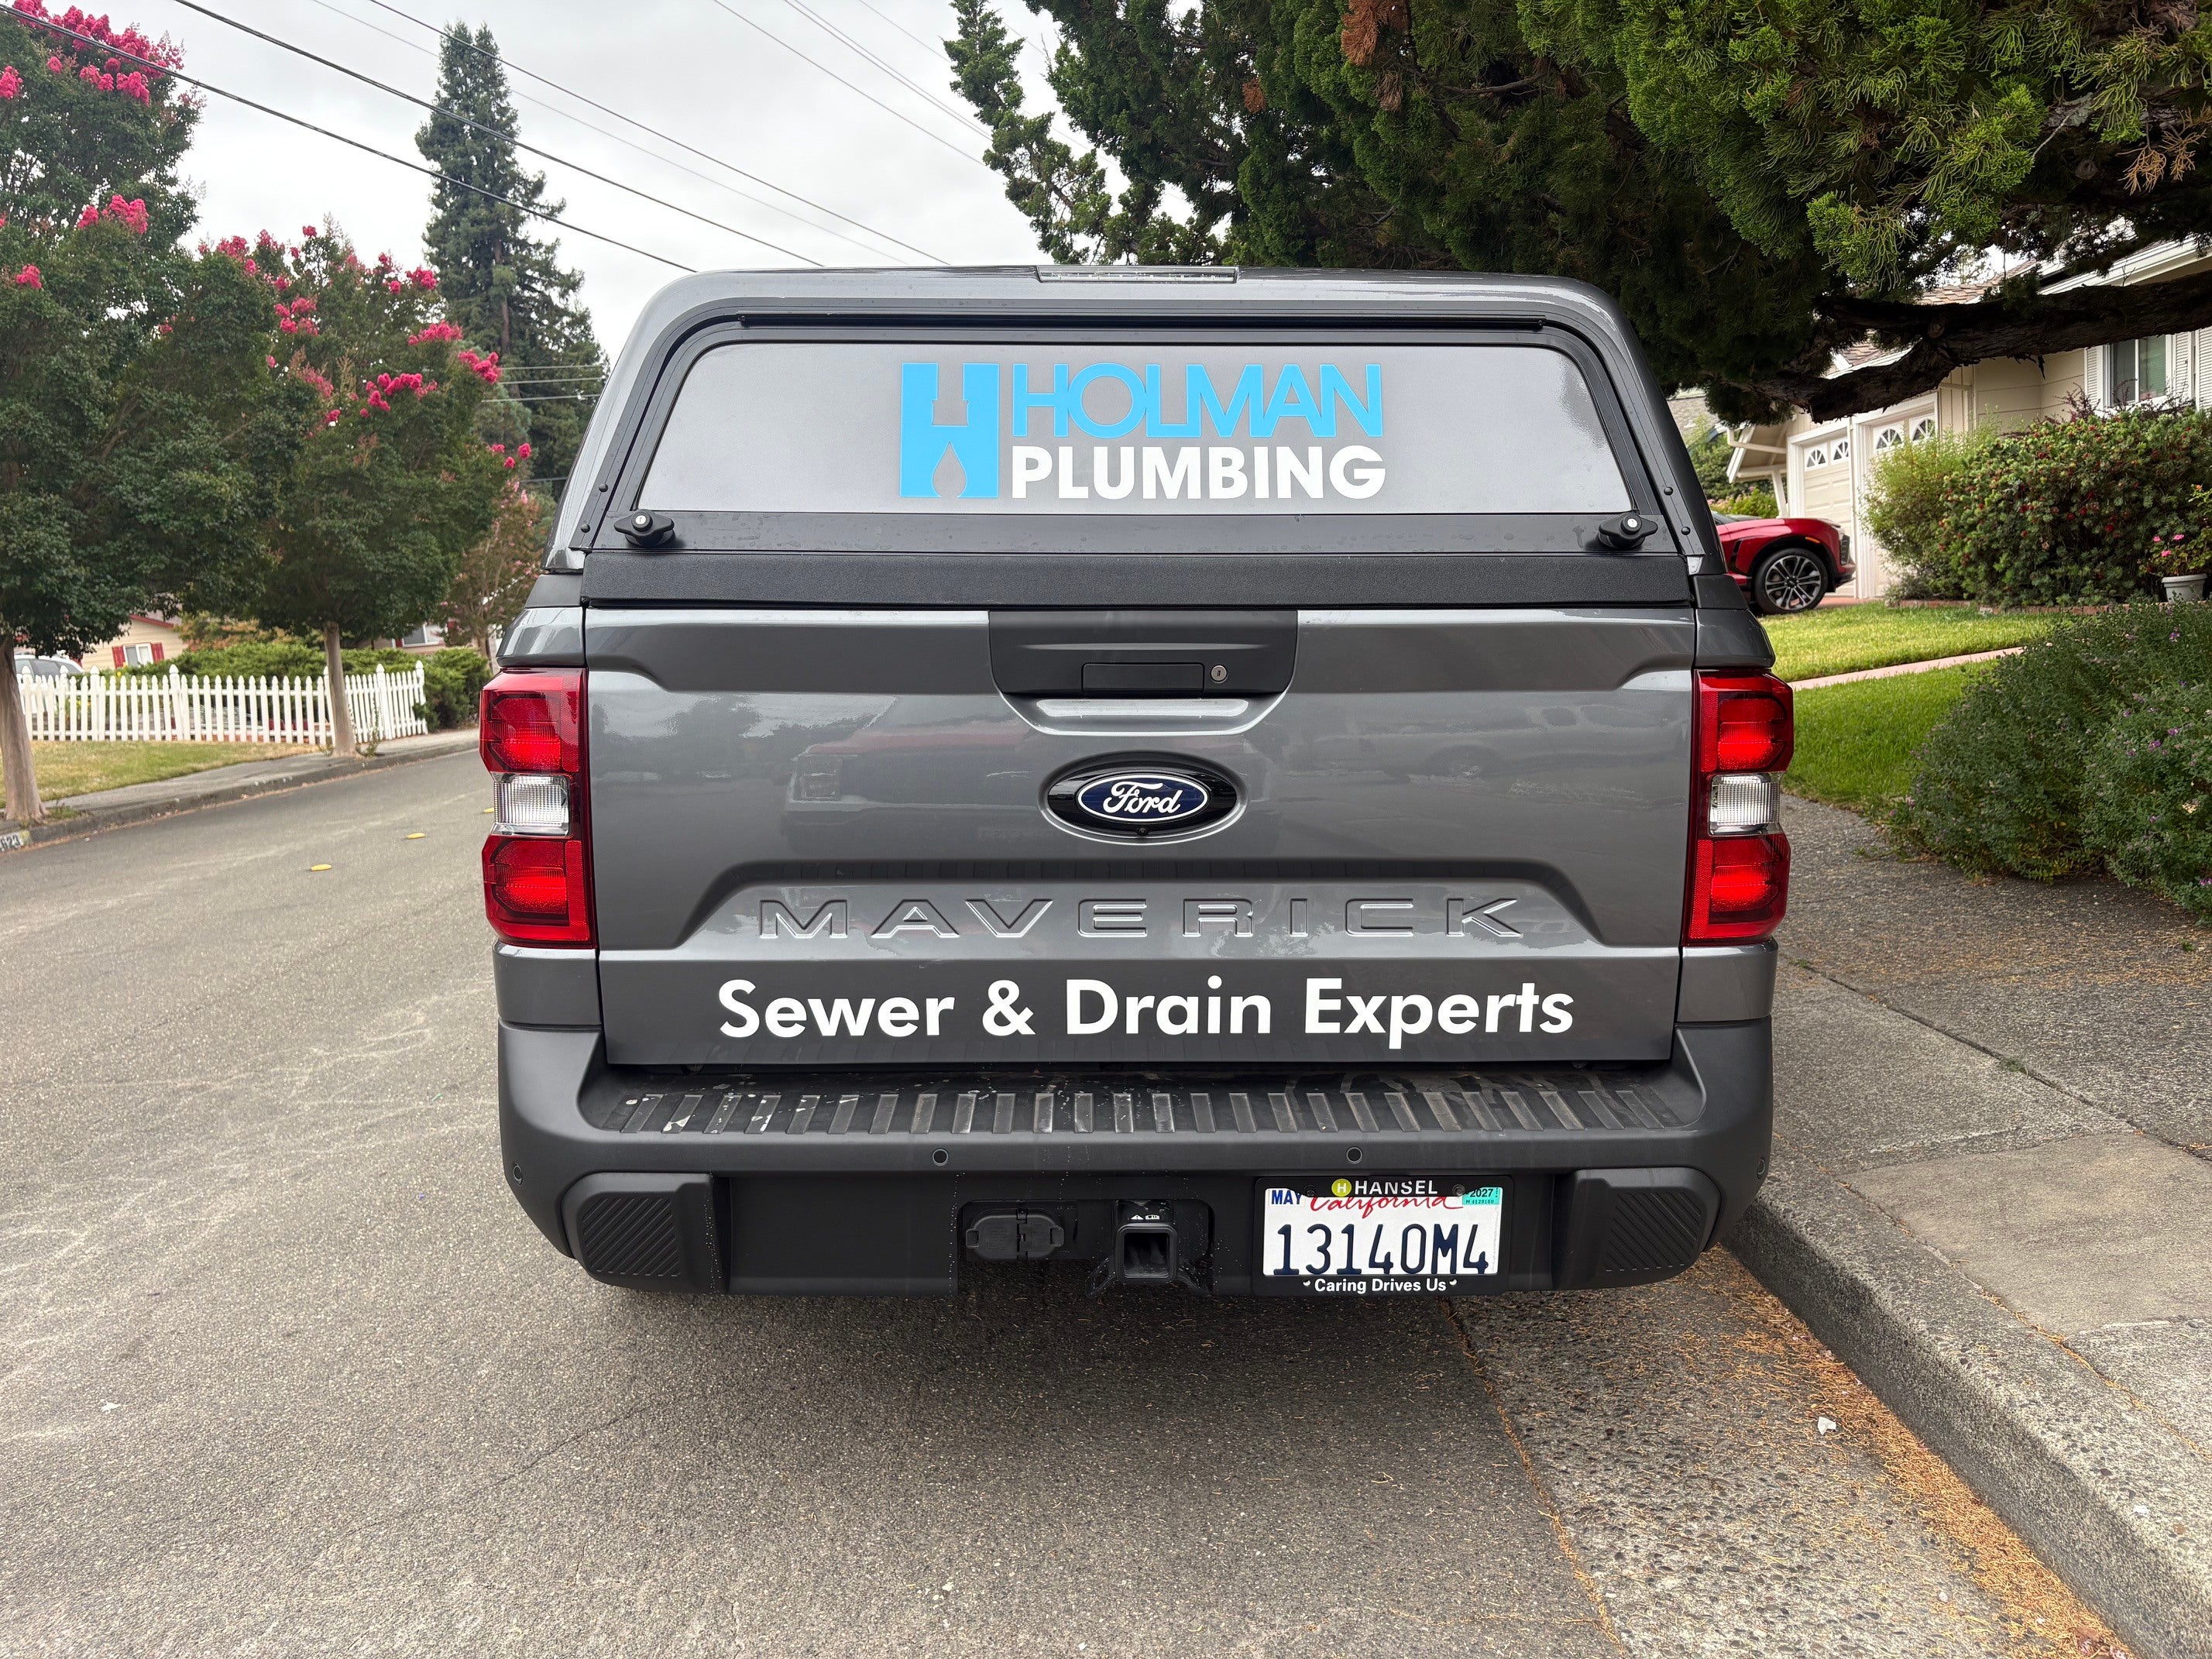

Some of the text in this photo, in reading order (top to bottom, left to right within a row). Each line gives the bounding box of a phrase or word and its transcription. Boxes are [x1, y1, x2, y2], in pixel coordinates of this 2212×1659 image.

[1012, 362, 1383, 438] HOLMAN
[1012, 445, 1386, 500] PLUMBING
[1102, 781, 1183, 814] Ford
[0, 834, 20, 850] 623
[759, 898, 1523, 939] MAVERICK
[719, 975, 1575, 1049] Sewer & Drain Experts
[1272, 1190, 1302, 1205] MAY
[1355, 1180, 1438, 1195] HANSEL
[1469, 1188, 1494, 1197] 2027
[1273, 1224, 1489, 1275] 13140M4
[1314, 1278, 1446, 1294] Caring Drives Us
